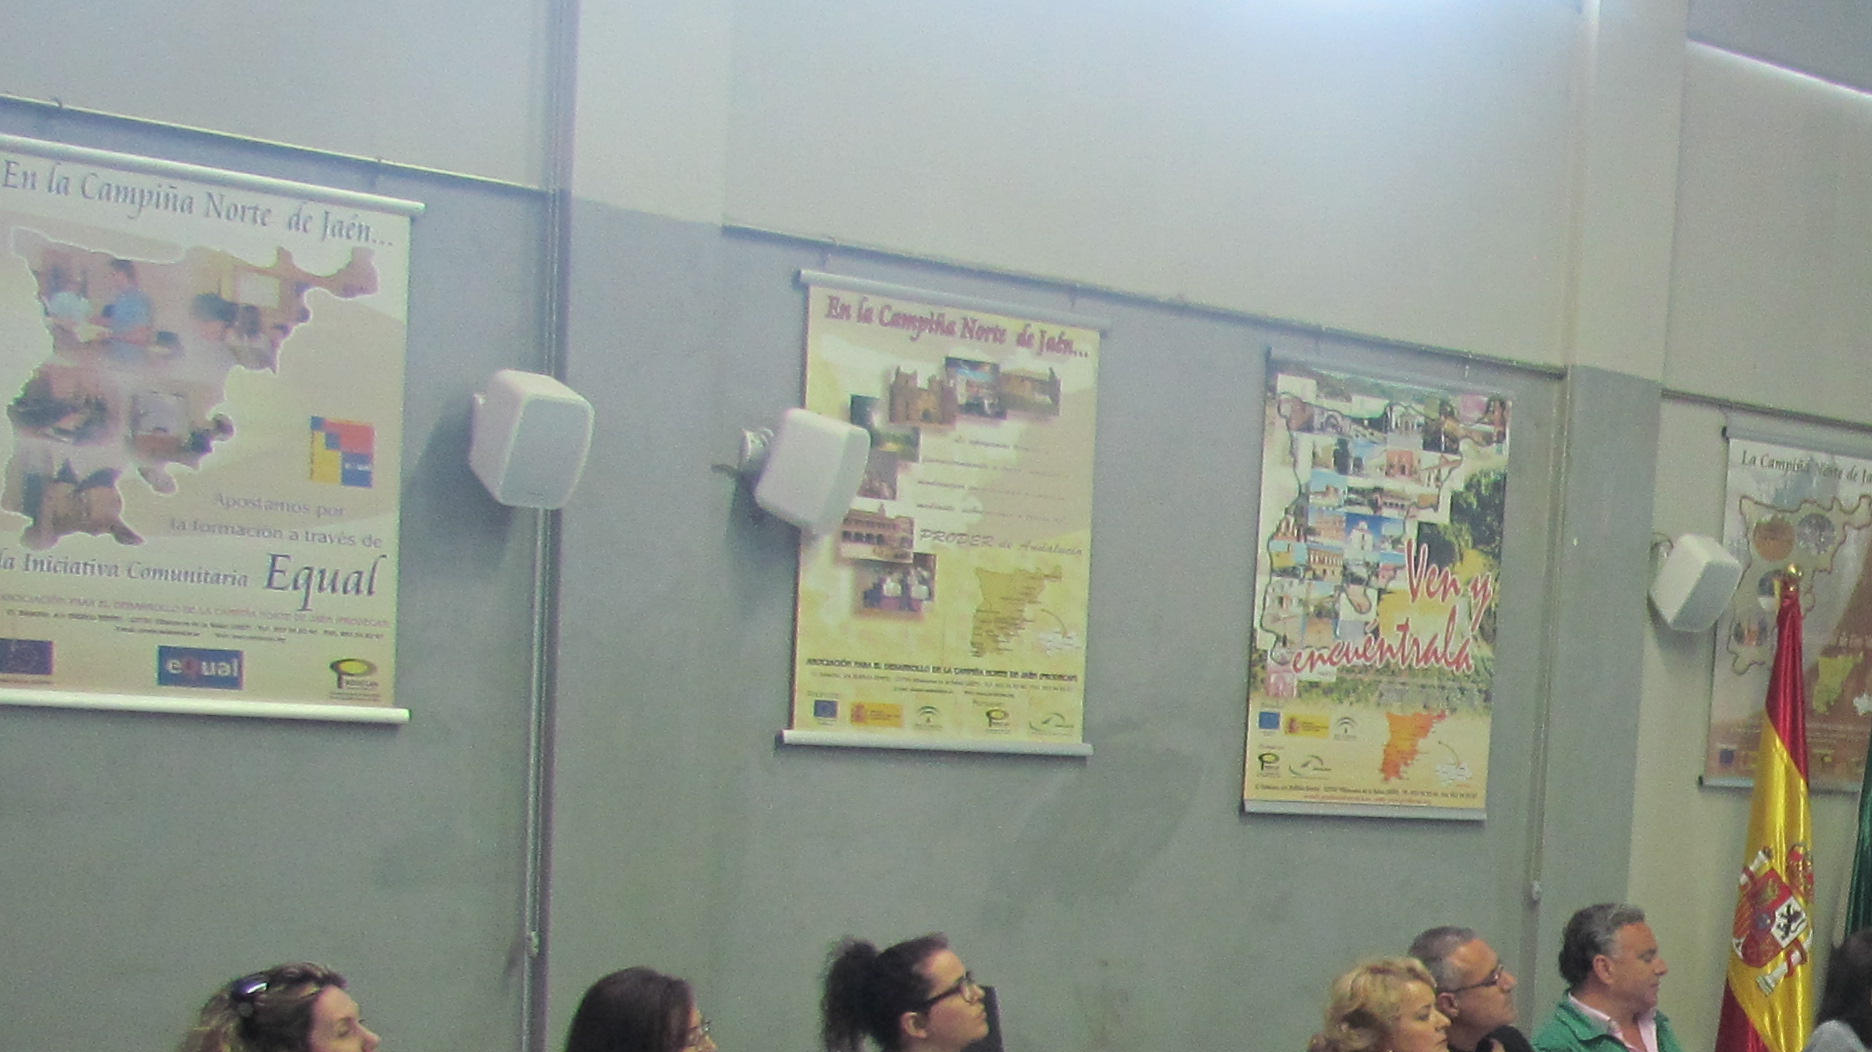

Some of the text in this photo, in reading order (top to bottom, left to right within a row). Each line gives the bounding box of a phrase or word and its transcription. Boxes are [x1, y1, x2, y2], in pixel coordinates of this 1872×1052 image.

[2, 159, 37, 191] En
[46, 160, 69, 197] la
[80, 172, 195, 220] Campiña
[204, 191, 273, 228] Norte
[287, 203, 313, 235] de
[825, 295, 852, 319] En
[857, 297, 874, 324] la
[879, 305, 957, 342] Campiña
[960, 317, 1006, 344] Norte
[1016, 324, 1034, 348] de
[1741, 450, 1757, 466] La
[1847, 465, 1858, 481] de
[170, 518, 187, 531] la
[289, 530, 300, 541] a
[304, 530, 356, 547] través
[361, 533, 383, 549] de
[215, 493, 345, 518] Apostamos por
[23, 551, 121, 579] Iniciativa
[126, 560, 250, 589] Comunitaria
[262, 552, 388, 612] Equal
[1404, 537, 1494, 634] Ven y
[1291, 605, 1476, 676] encuéntrala
